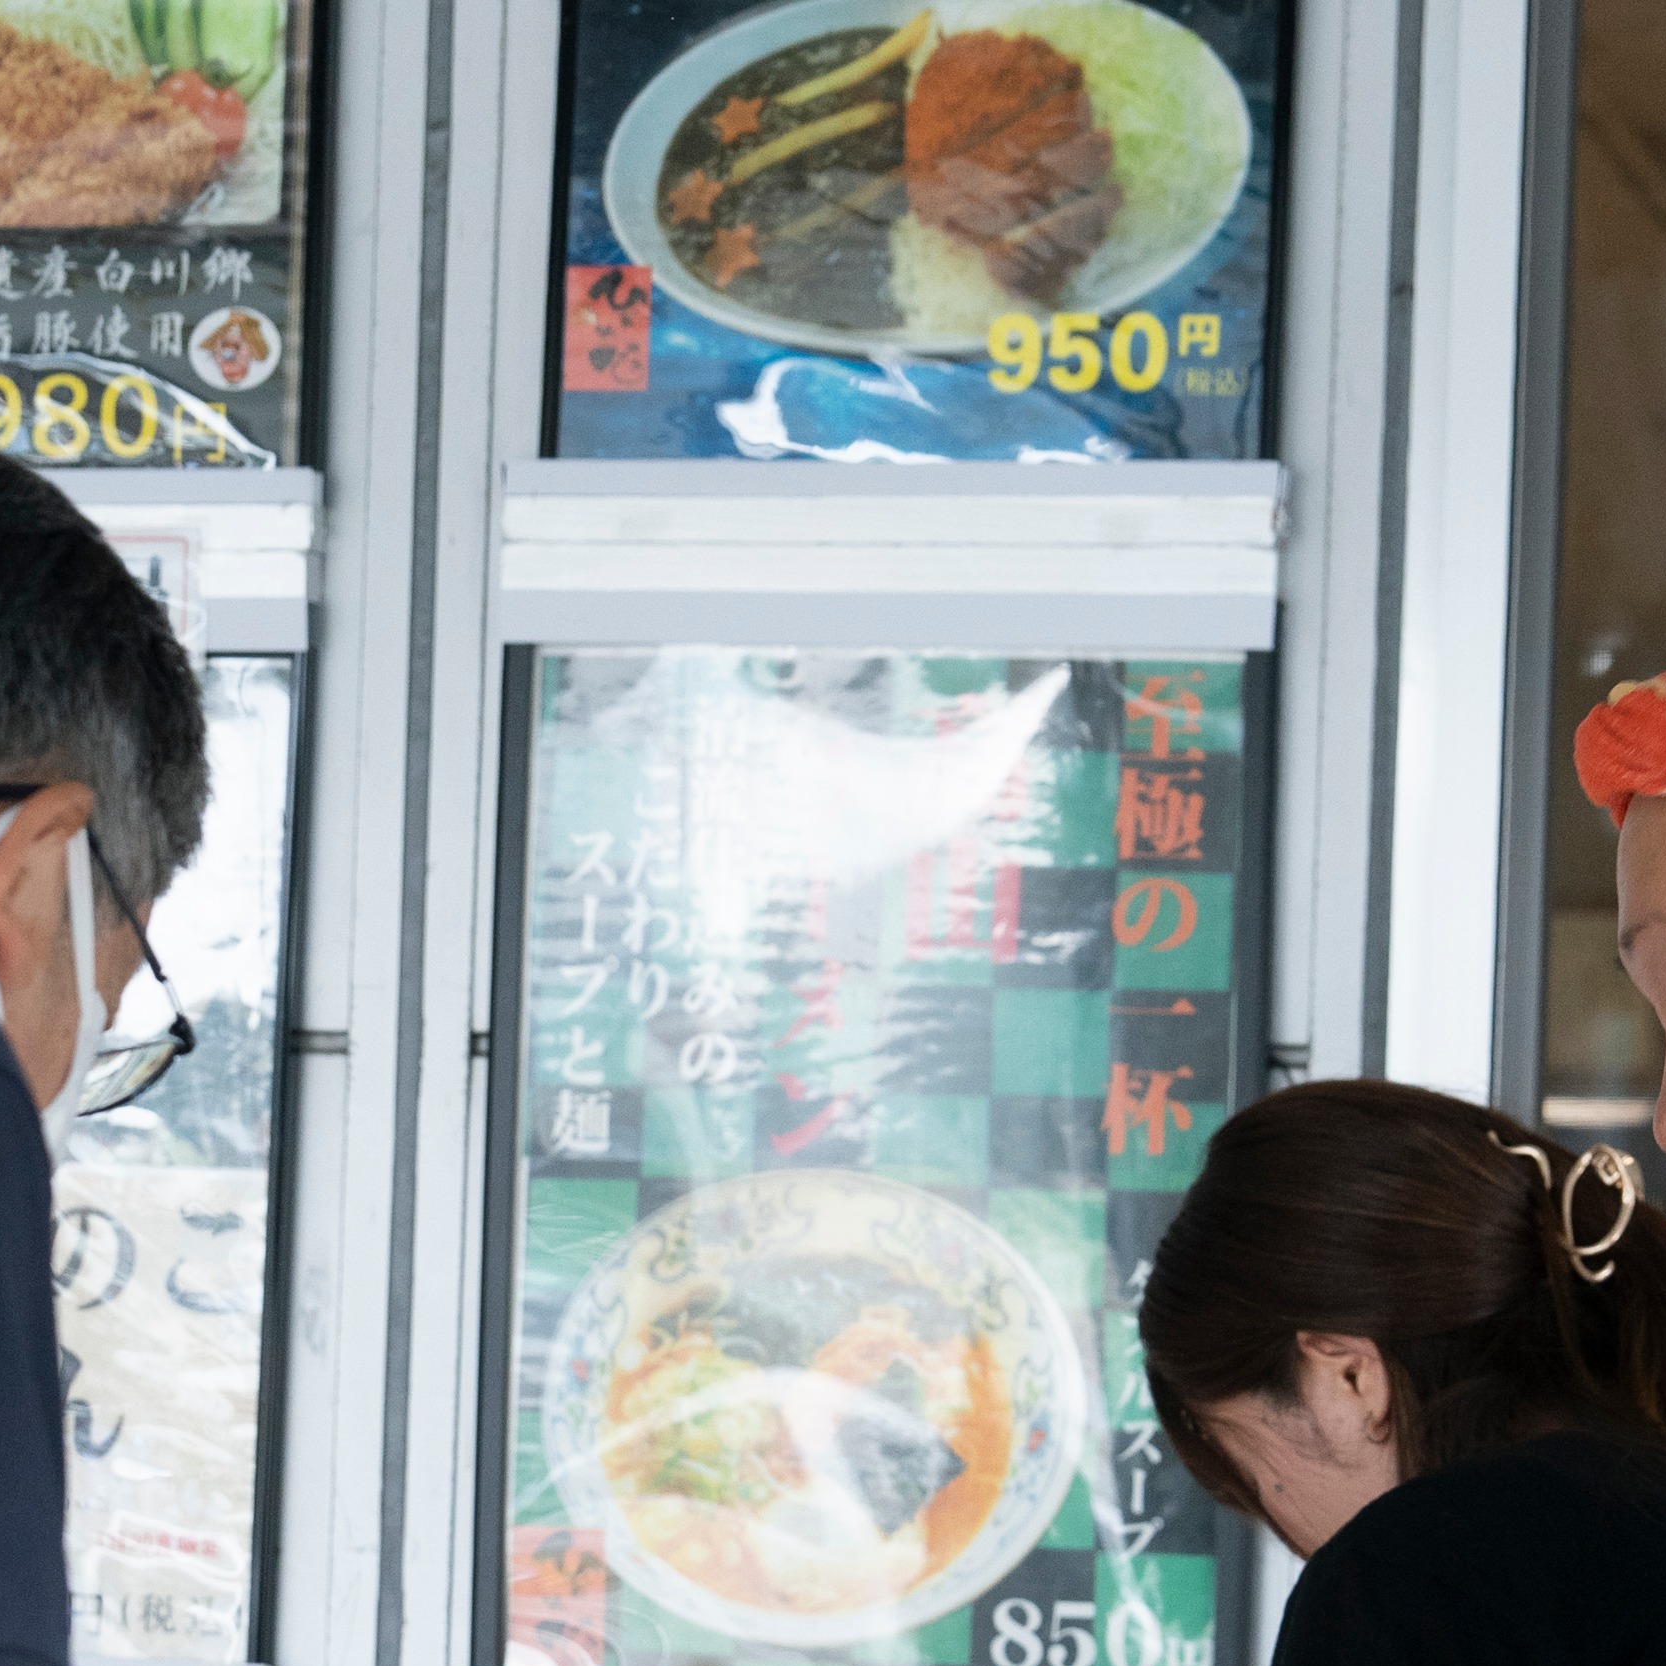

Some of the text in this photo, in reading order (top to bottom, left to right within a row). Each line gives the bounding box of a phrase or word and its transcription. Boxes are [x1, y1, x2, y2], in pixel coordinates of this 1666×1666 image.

[988, 312, 1221, 395] 950円
[550, 829, 620, 1153] スープと麺
[620, 762, 681, 1021] こだわり
[1101, 669, 1206, 1157] 至極の一杯
